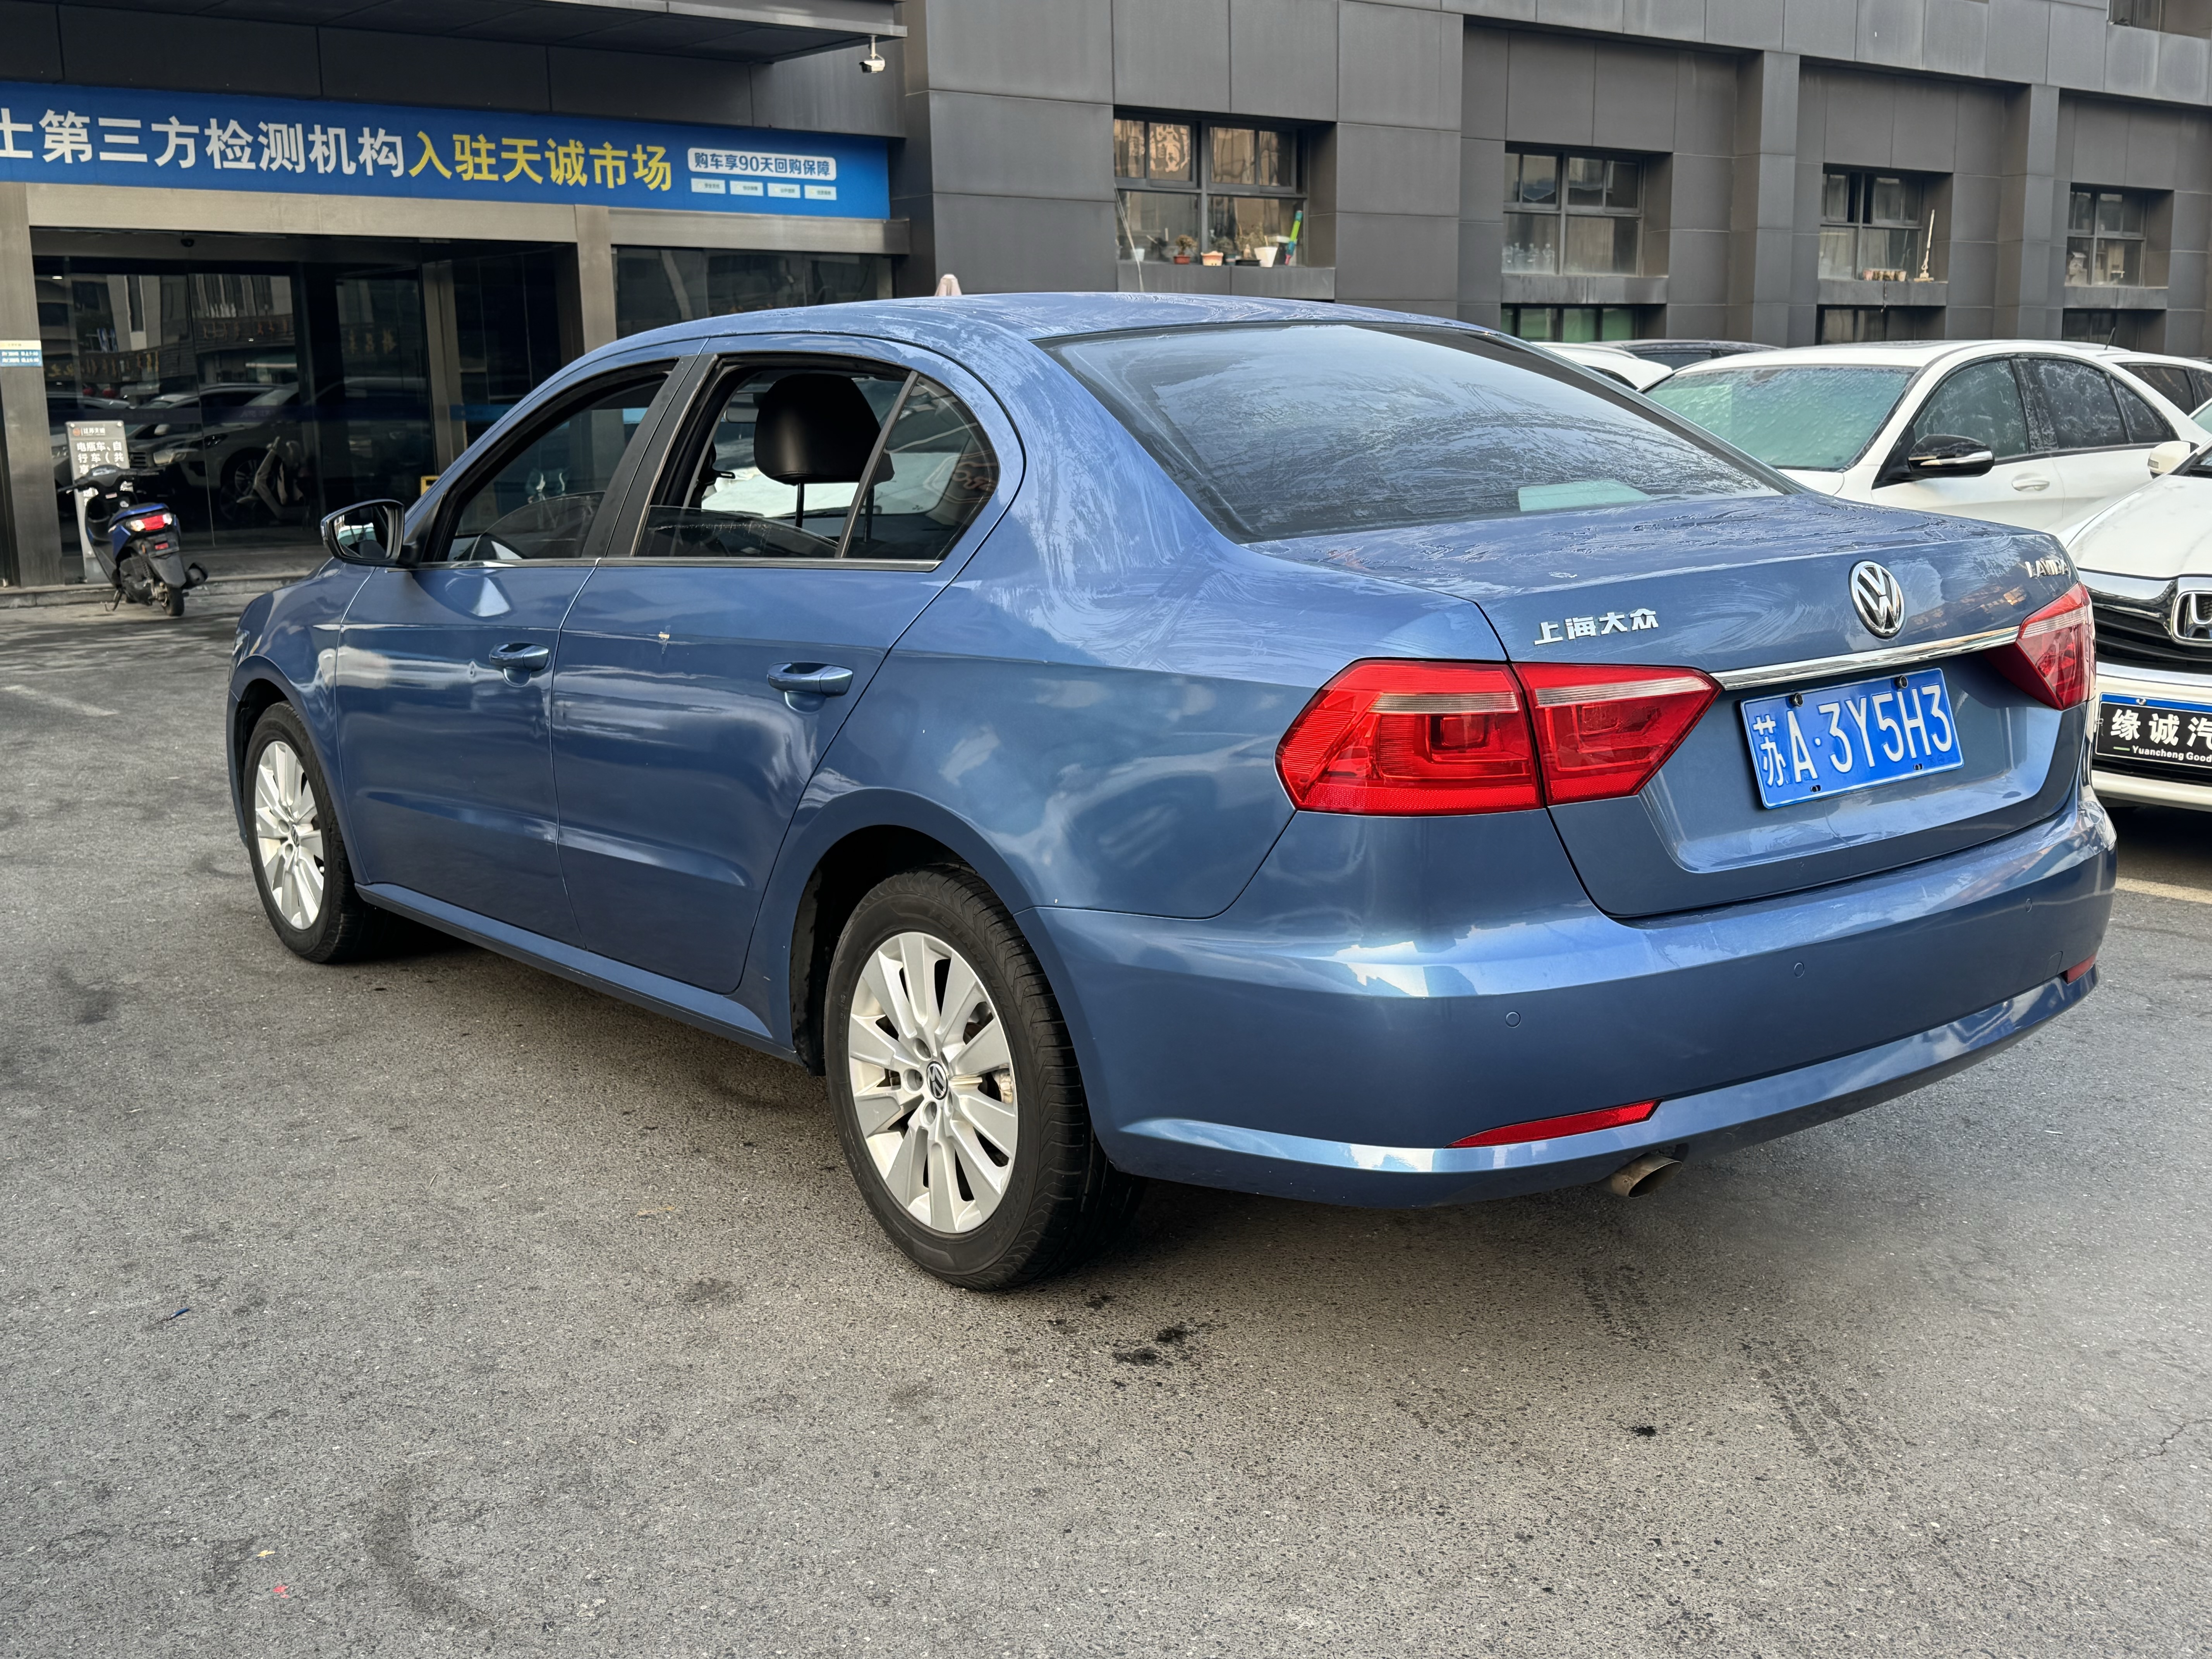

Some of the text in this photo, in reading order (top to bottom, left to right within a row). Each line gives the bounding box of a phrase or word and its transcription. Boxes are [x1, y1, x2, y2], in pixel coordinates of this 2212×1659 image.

[695, 152, 830, 177] 购车享90天回购保障
[77, 441, 122, 452] 电瓶车、自
[1534, 608, 1659, 645] 上海大众
[2111, 709, 2212, 750] 缘诚汽
[2133, 745, 2184, 760] Yuancheng
